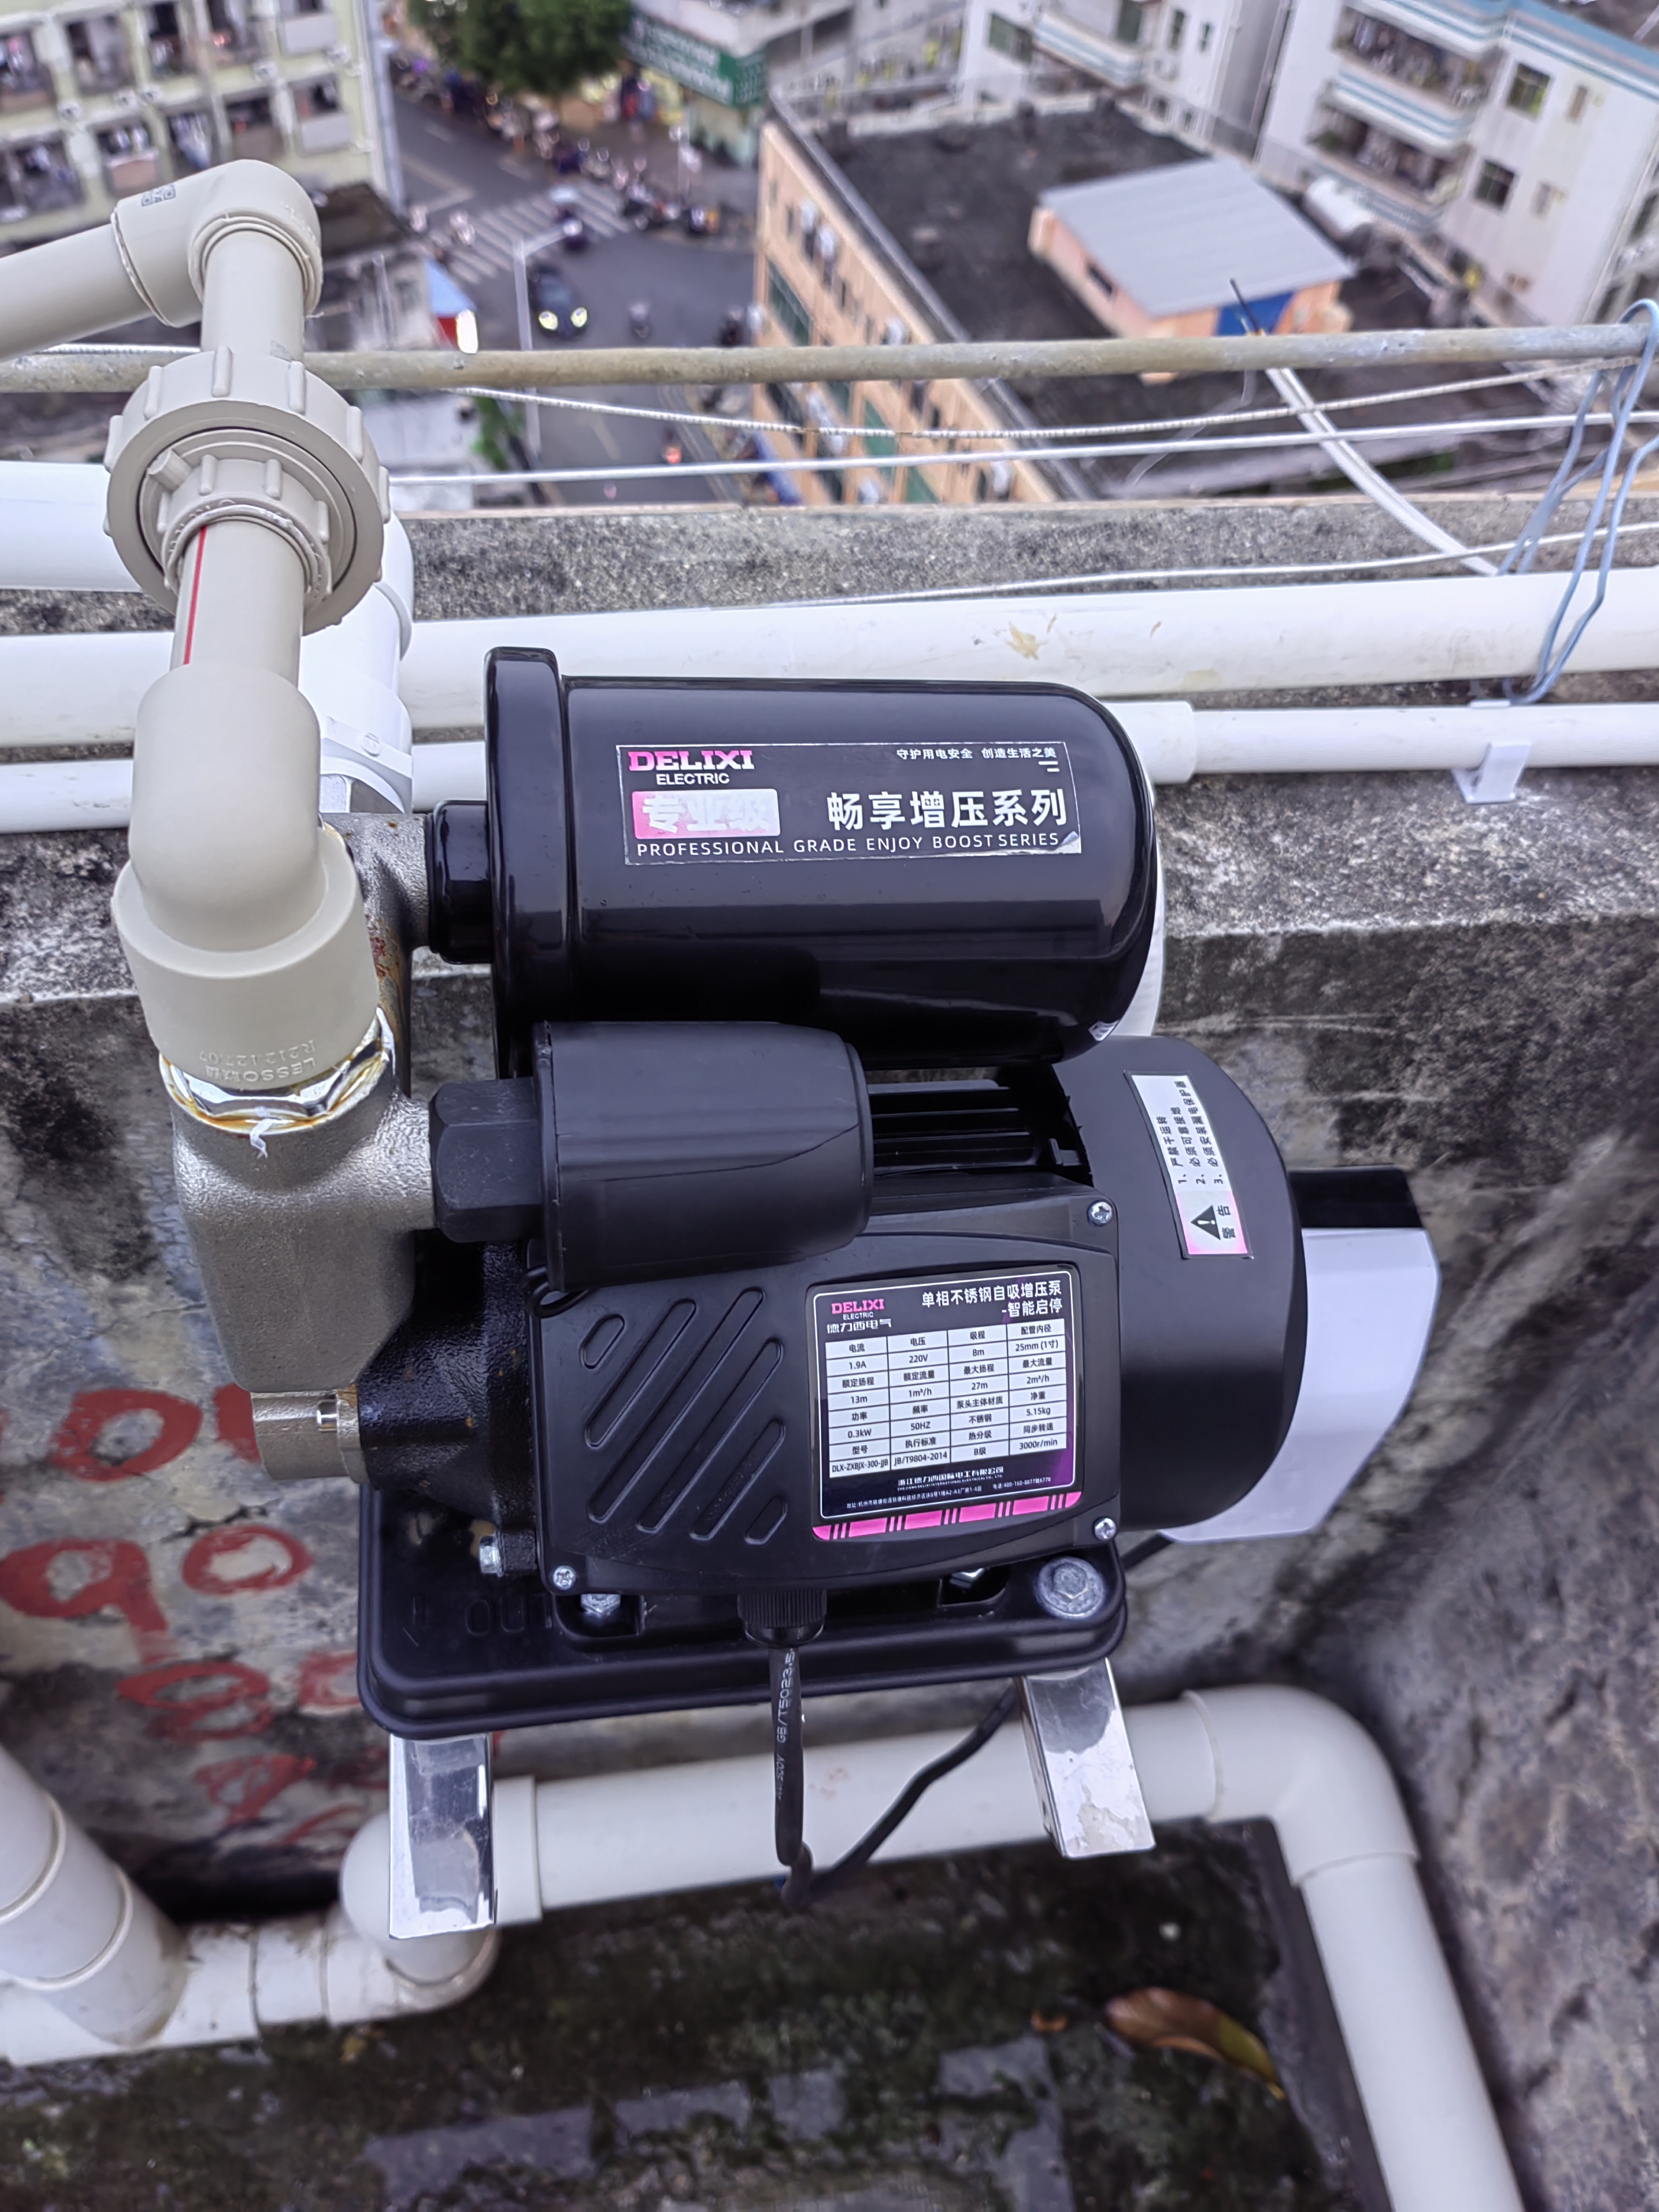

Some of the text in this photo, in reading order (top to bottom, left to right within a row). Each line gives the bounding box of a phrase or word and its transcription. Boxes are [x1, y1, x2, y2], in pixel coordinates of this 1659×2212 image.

[896, 747, 1057, 760] 守护用电安全 创造生活之美
[629, 750, 755, 771] DELIXI
[656, 773, 730, 786] ELECTRIC
[642, 794, 777, 834] 专业级
[826, 788, 1067, 831] 畅享增压系列
[637, 832, 1059, 857] PROFESSIONAL GRADE ENJOY BOOST SERIES
[922, 1280, 1062, 1308] 单相不锈钢自吸增压泵
[832, 1299, 885, 1314] DELIXI
[843, 1312, 874, 1320] ELECTRIC
[827, 1318, 892, 1334] 德力西电气
[1021, 1324, 1051, 1335] 配管内径
[970, 1330, 985, 1340] 吸程
[911, 1337, 926, 1346] 电压
[849, 1343, 865, 1353] 电流
[909, 1354, 928, 1364] 220V
[1023, 1357, 1053, 1368] 最大流量
[849, 1361, 866, 1370] 1.9A
[964, 1364, 995, 1375] 最大扬程
[903, 1370, 935, 1381] 额定流量
[842, 1377, 874, 1388] 额定扬程
[972, 1382, 988, 1391] 27m
[851, 1395, 867, 1404] 13m
[1030, 1391, 1046, 1400] 净重
[956, 1396, 1003, 1410] 泵头主体材质
[913, 1405, 928, 1414] 频率
[1027, 1407, 1051, 1417] 5.15kg
[852, 1412, 867, 1421] 功率
[969, 1414, 992, 1424] 不锈钢
[911, 1421, 930, 1431] 50HZ
[1023, 1422, 1054, 1434] 同步转速
[848, 1428, 872, 1438] 0.3kW
[969, 1430, 992, 1441] 热分级
[906, 1437, 936, 1448] 执行标准
[1019, 1439, 1057, 1450] 3000r/min
[852, 1445, 868, 1455] 型号
[894, 1452, 947, 1466] JB/T9804-2014
